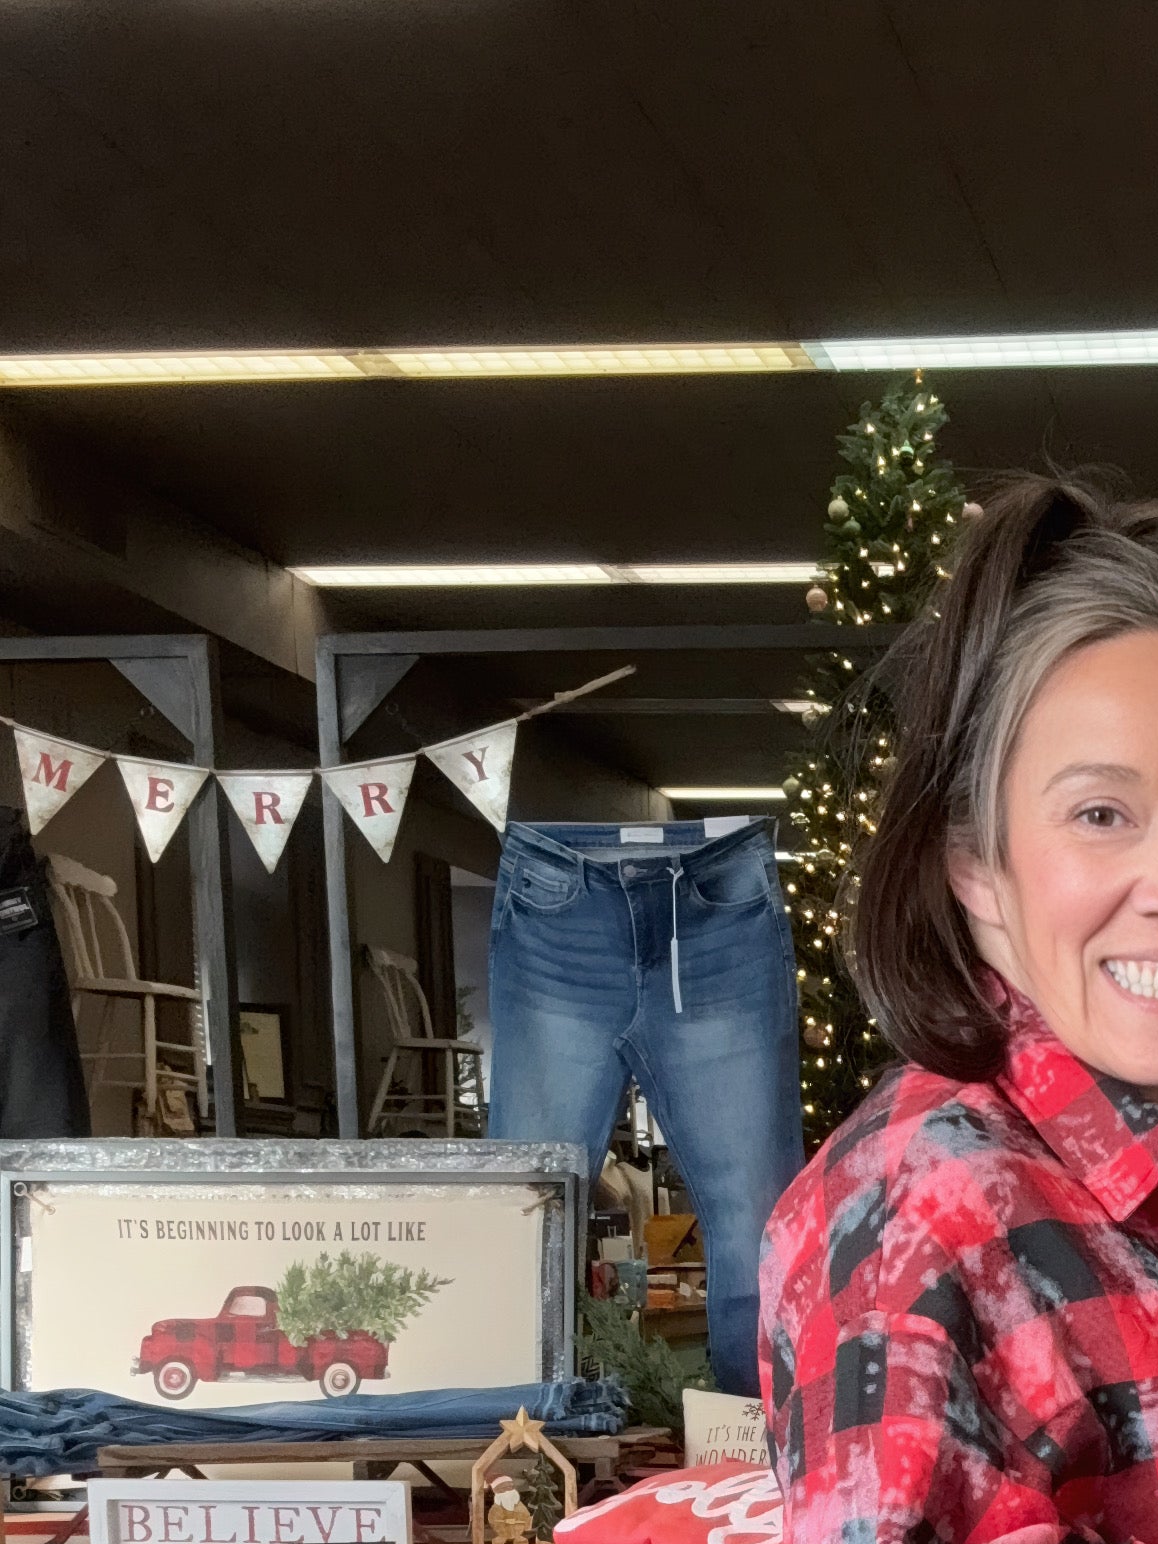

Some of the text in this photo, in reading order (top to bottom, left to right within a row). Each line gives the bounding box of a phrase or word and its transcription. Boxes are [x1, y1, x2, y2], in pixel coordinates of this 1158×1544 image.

[31, 746, 491, 826] MERRY
[117, 1218, 427, 1242] IT'S BEGINNING TO LOOK A LOT LIKE
[706, 1425, 731, 1443] IT'S
[737, 1425, 757, 1443] THE
[121, 1504, 386, 1544] BELIEVE
